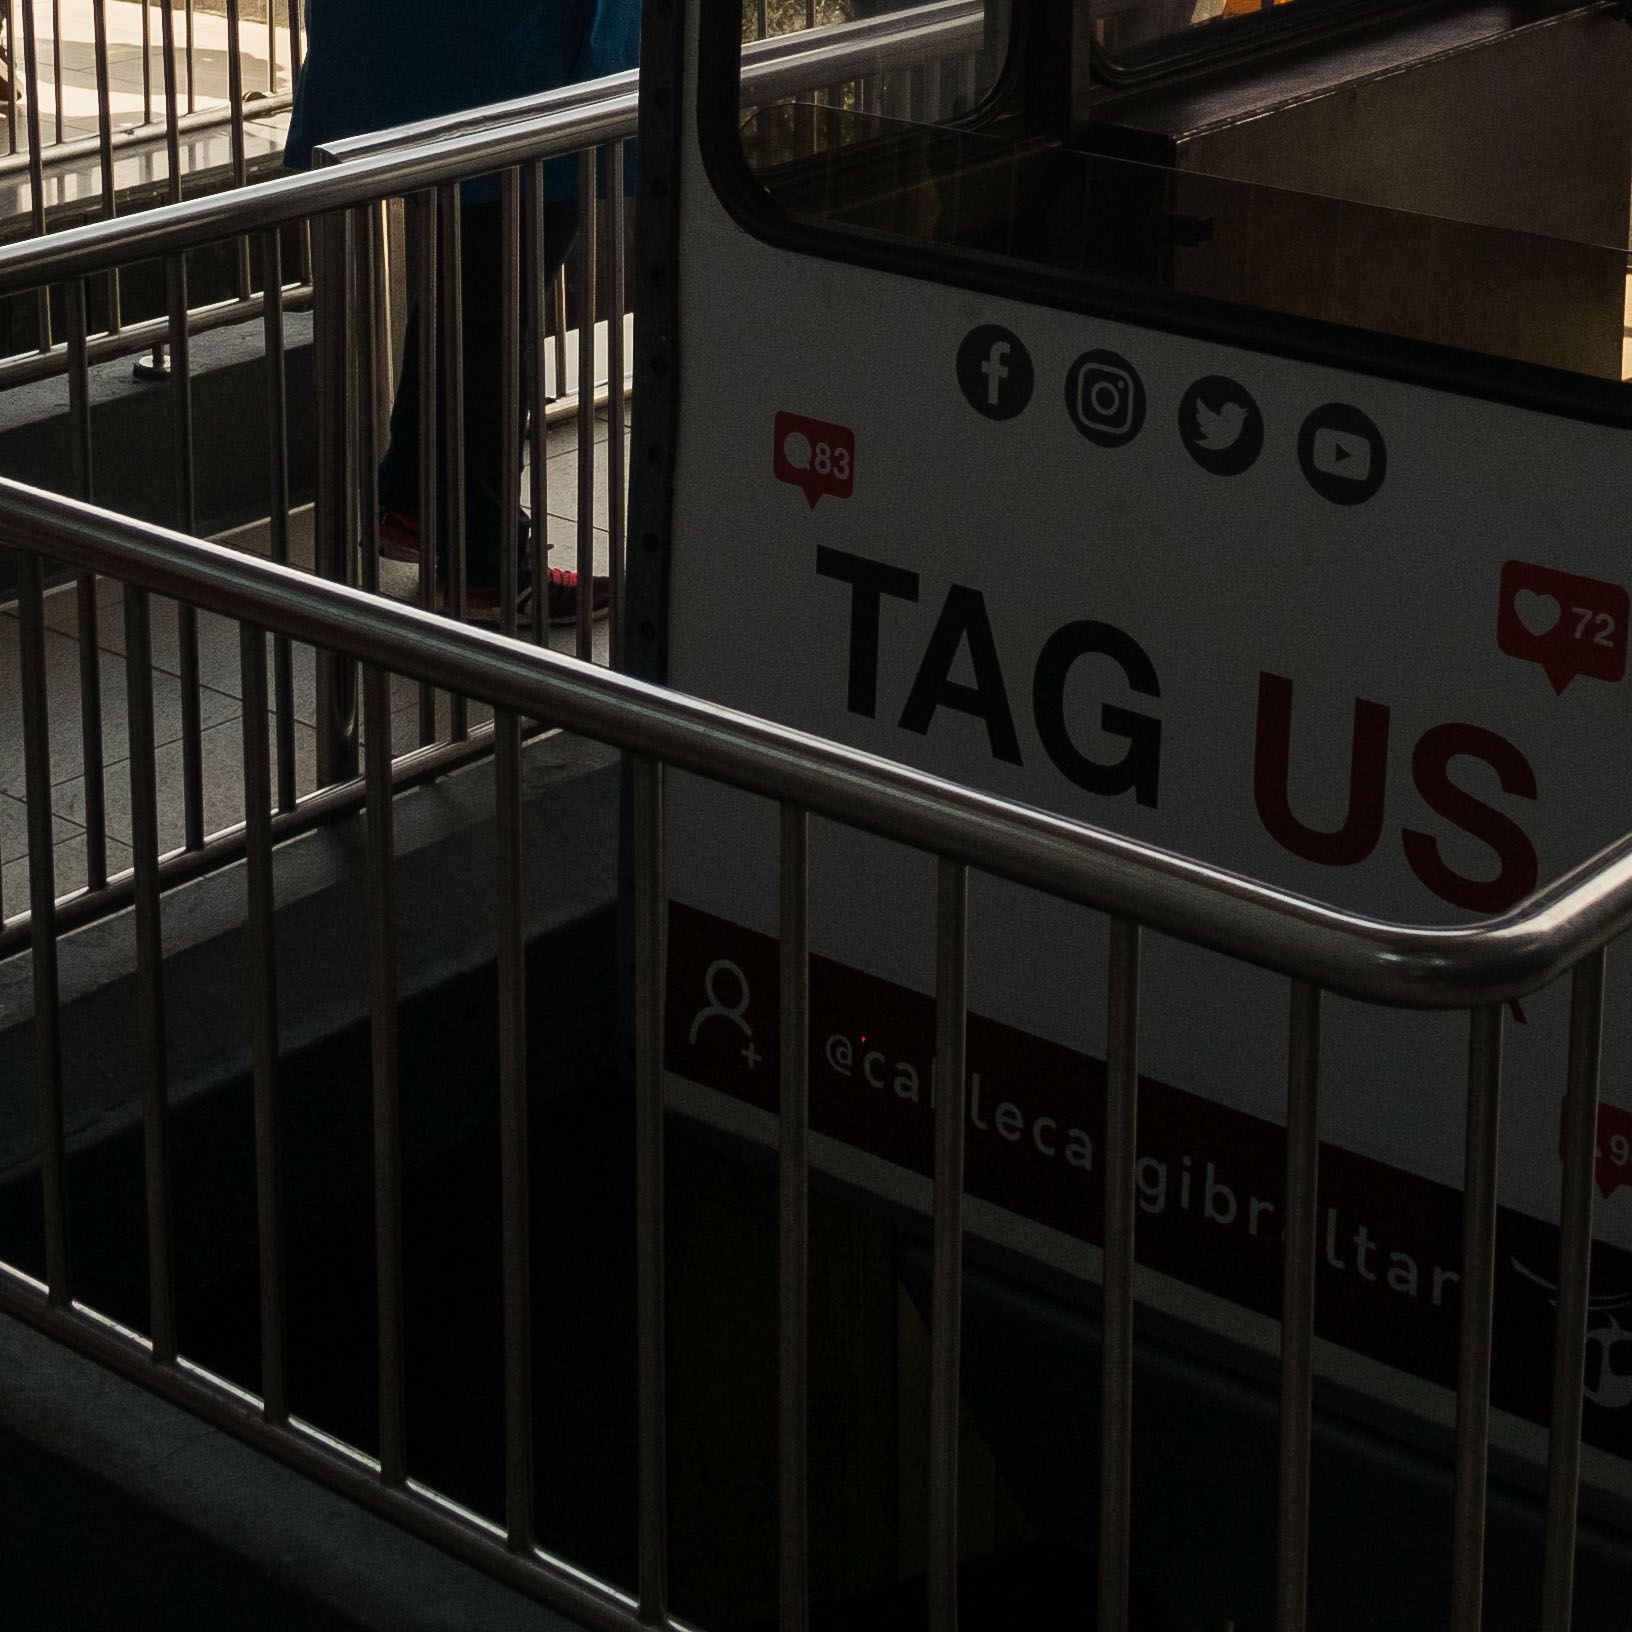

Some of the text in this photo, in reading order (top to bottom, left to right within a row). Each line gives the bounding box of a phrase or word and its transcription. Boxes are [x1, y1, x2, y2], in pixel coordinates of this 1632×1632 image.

[814, 441, 850, 481] 83
[1571, 606, 1615, 648] 72
[816, 545, 1539, 915] TAG US
